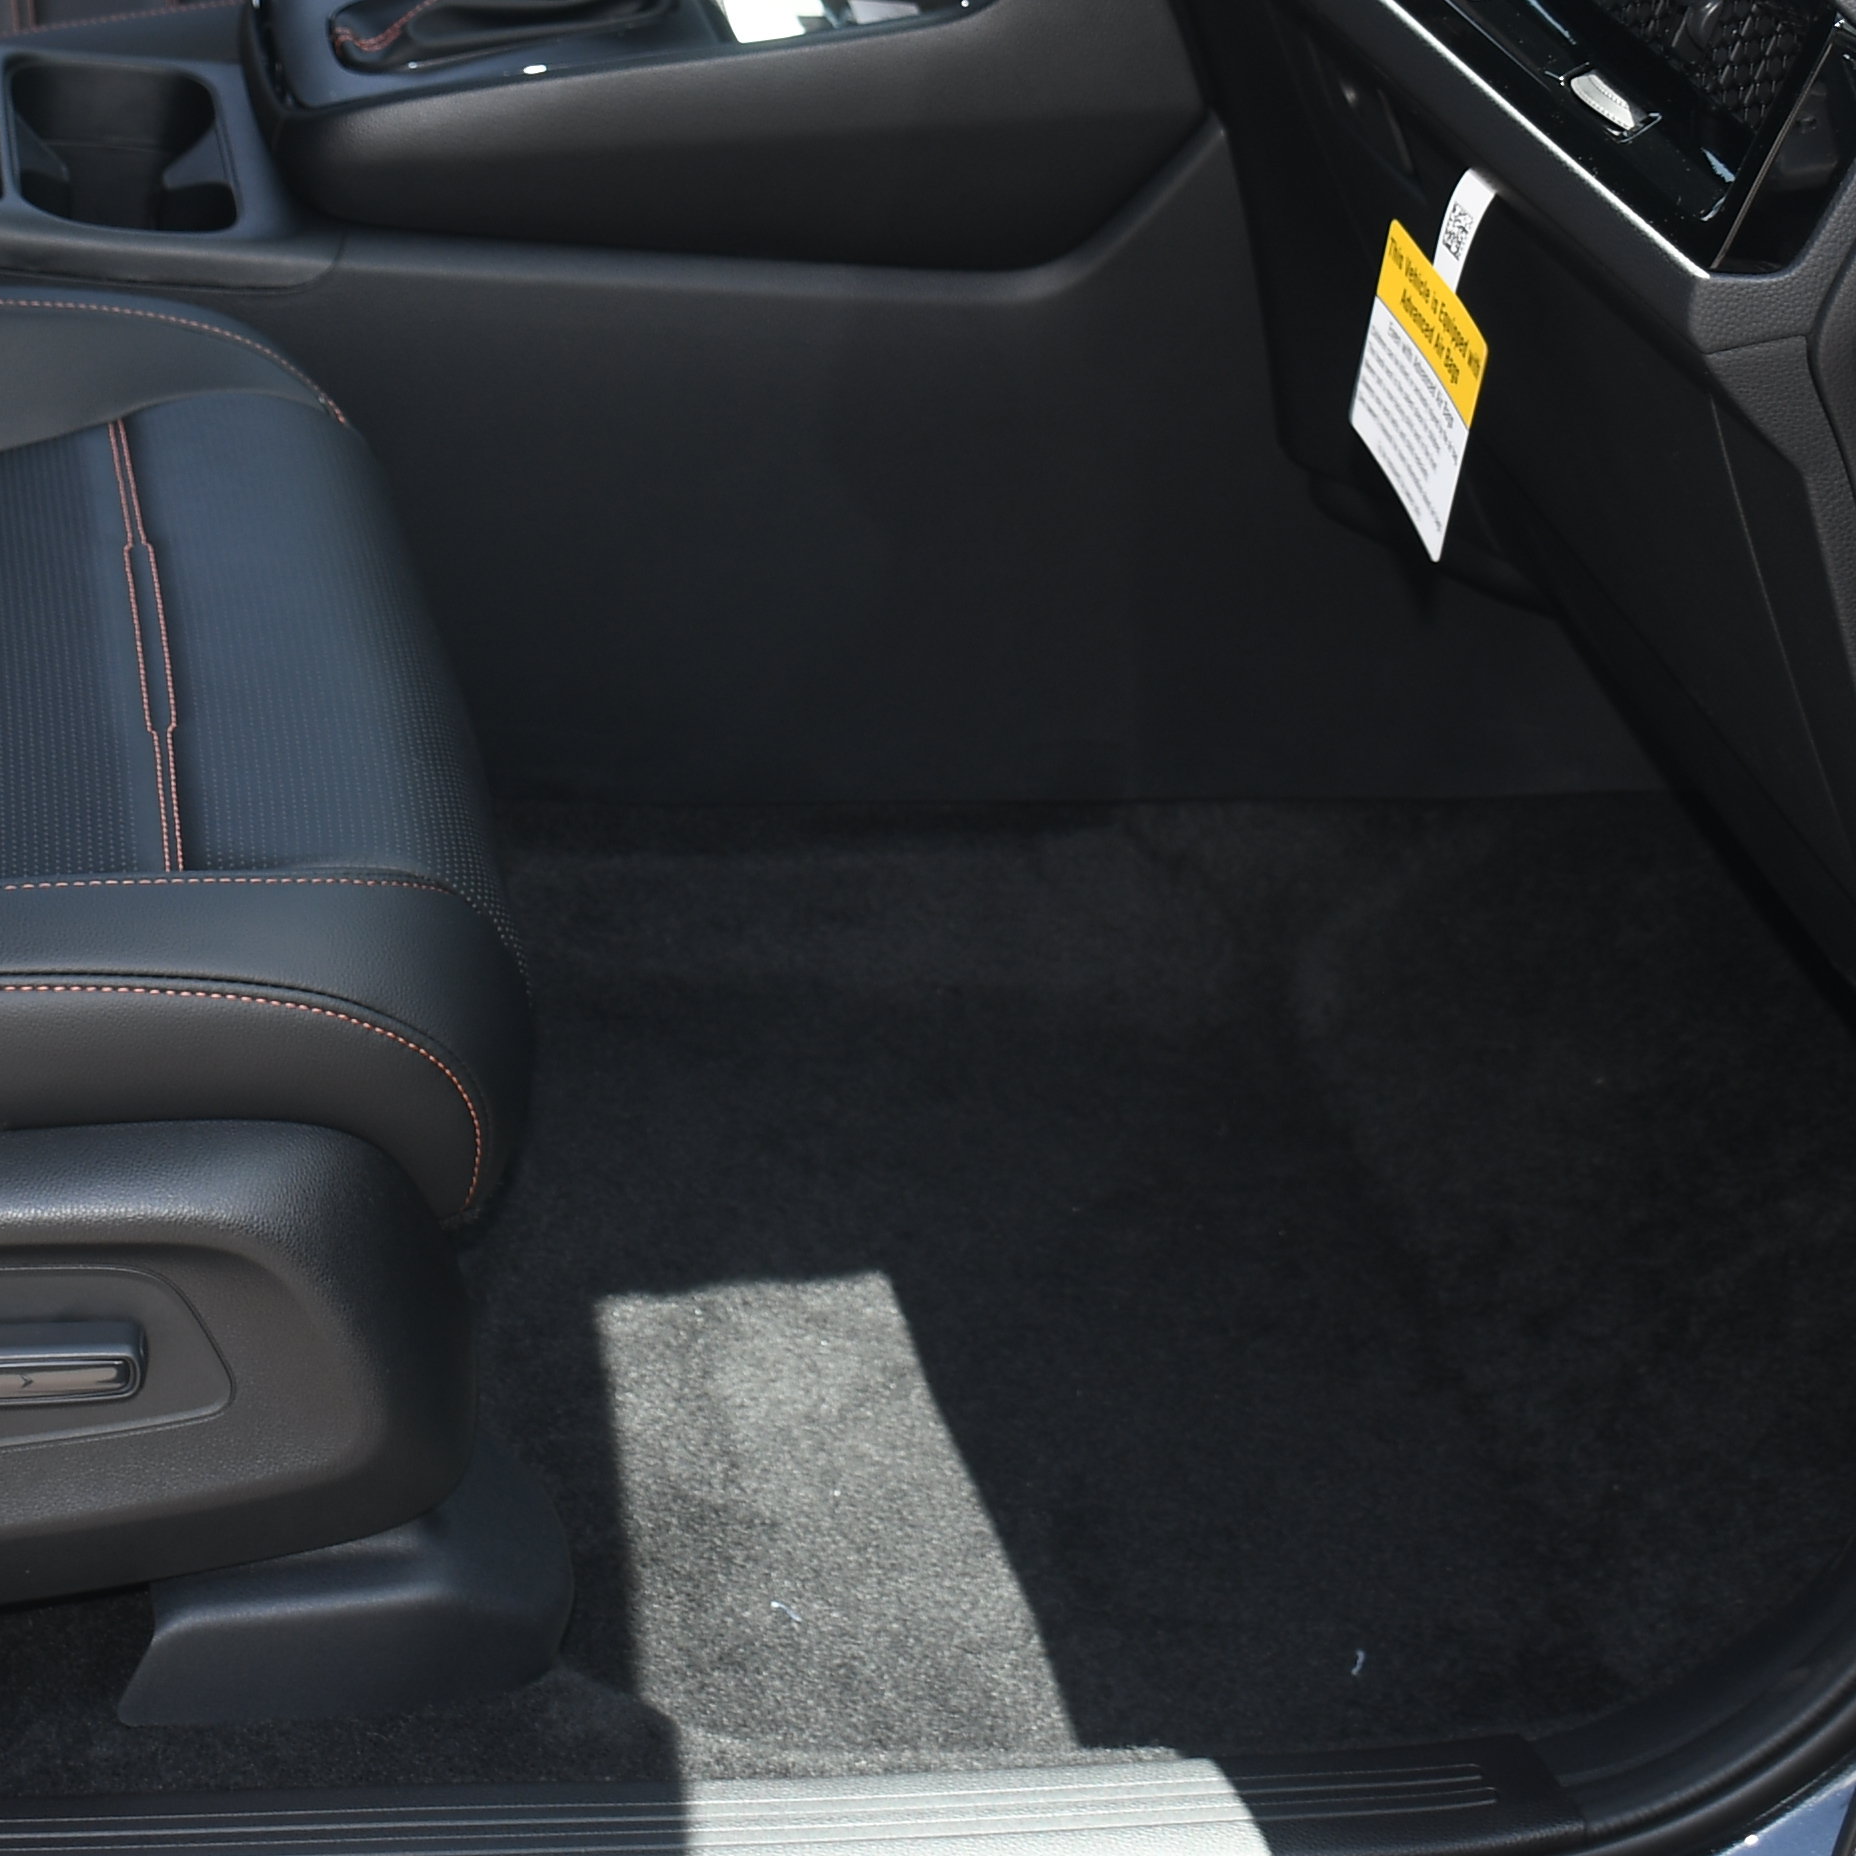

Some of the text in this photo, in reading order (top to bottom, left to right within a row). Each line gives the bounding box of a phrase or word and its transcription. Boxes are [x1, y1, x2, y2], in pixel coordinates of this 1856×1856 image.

[1388, 236, 1404, 270] This
[1405, 257, 1430, 304] Vehicle
[1439, 302, 1469, 358] Equipped
[1400, 288, 1460, 384] Advanced Air Bags
